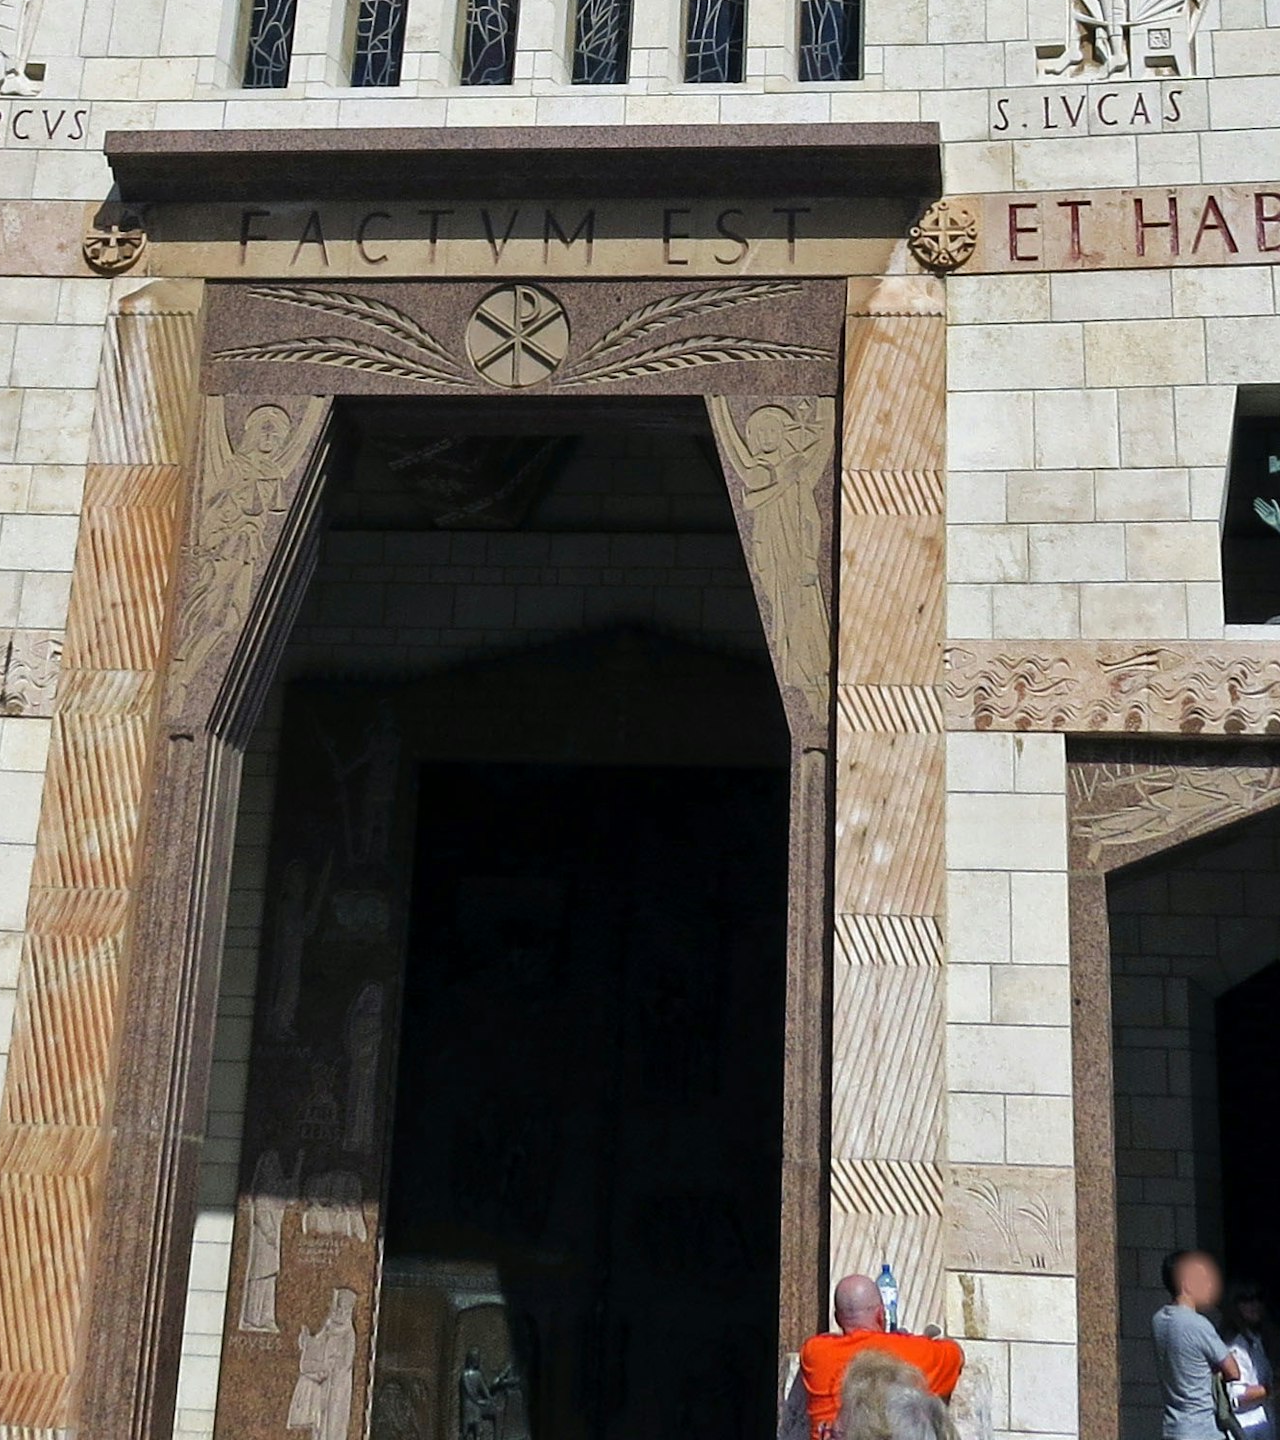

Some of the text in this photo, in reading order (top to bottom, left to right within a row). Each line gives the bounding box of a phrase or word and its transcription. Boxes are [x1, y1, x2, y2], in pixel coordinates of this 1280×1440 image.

[240, 207, 596, 267] FACTVM
[663, 206, 812, 266] EST
[1008, 200, 1092, 262] ET
